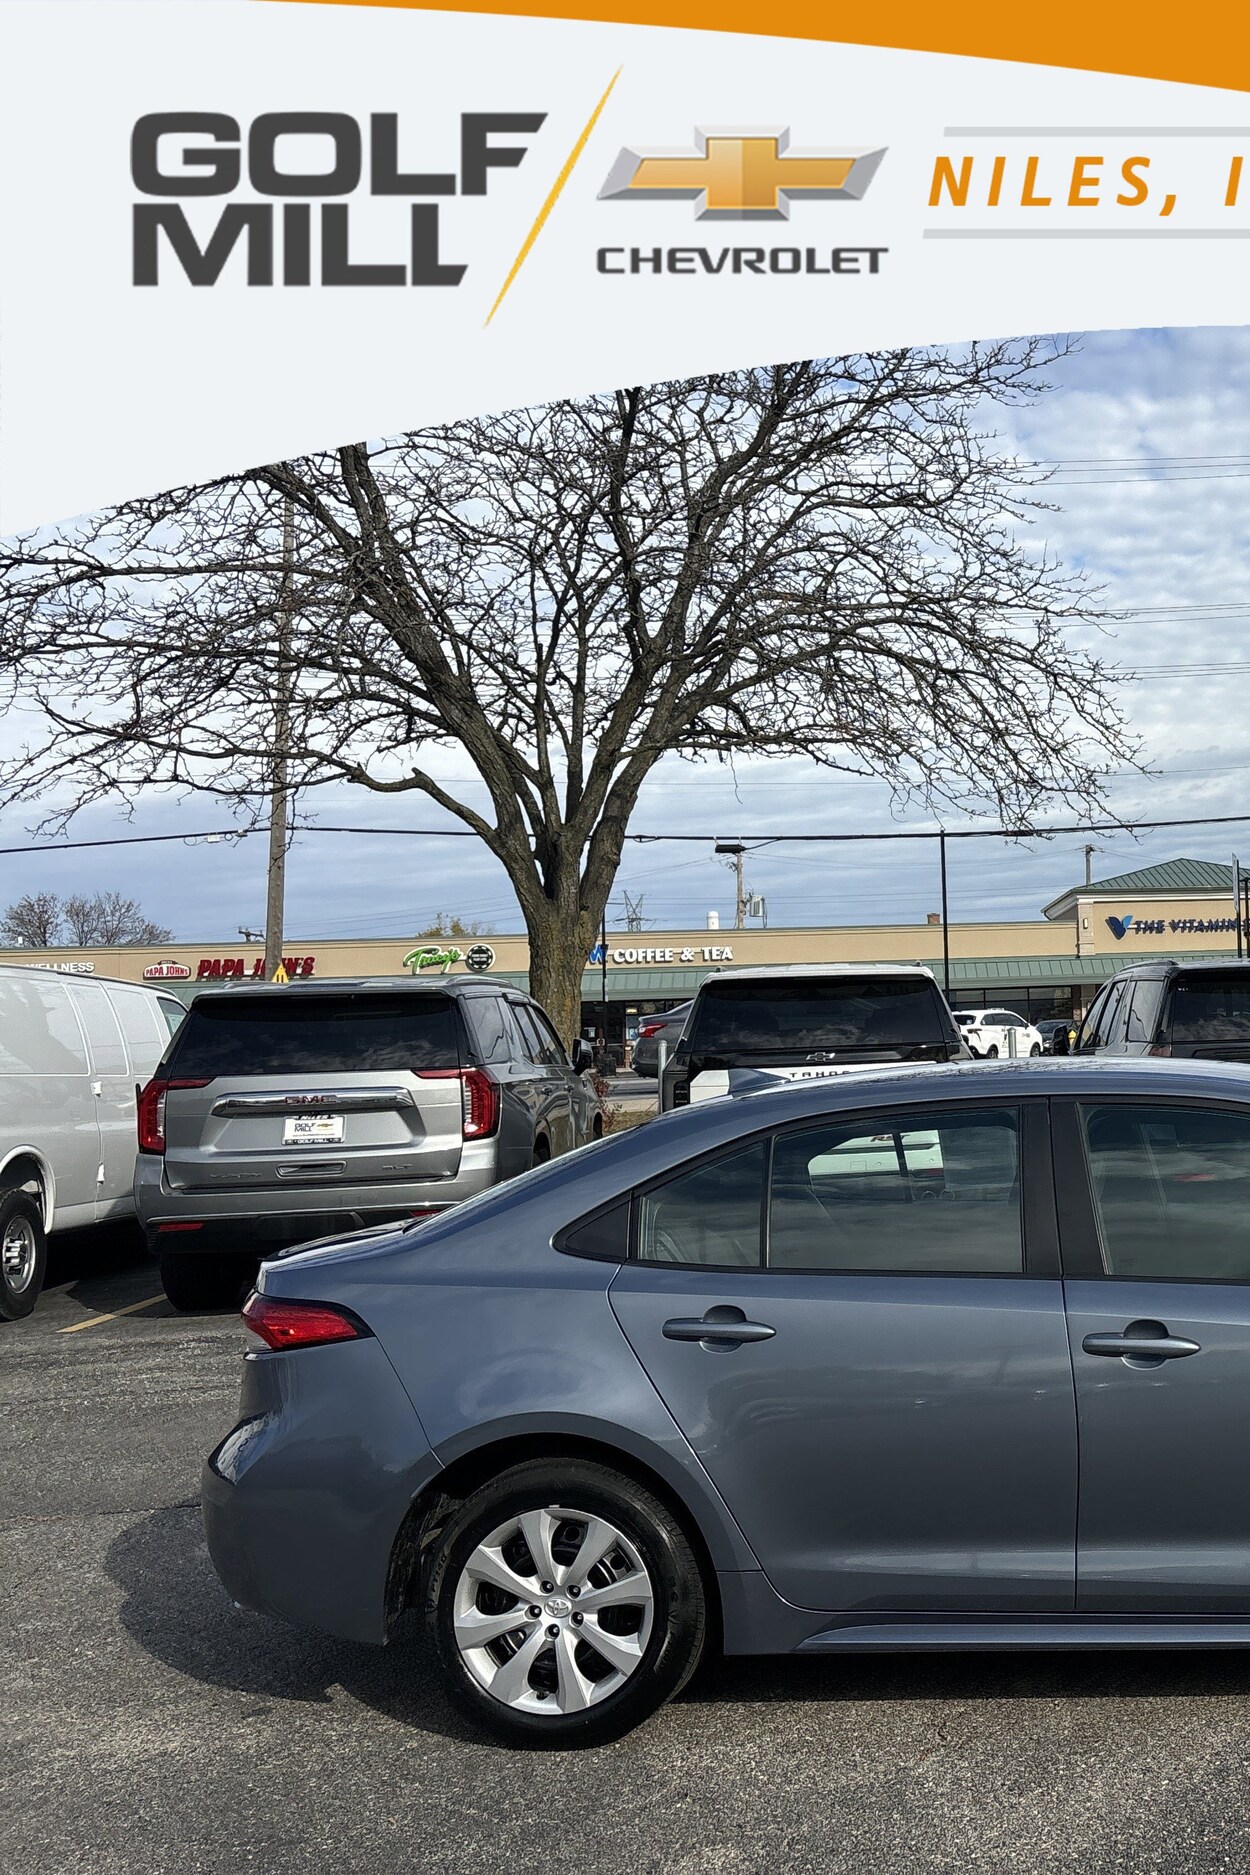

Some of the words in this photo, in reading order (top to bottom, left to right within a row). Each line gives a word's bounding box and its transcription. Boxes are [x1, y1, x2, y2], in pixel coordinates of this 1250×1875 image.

[1134, 919, 1166, 935] THE
[1168, 917, 1239, 934] VITAMIN
[612, 948, 674, 965] COFFEE
[681, 947, 695, 962] &
[701, 946, 734, 962] TEA
[145, 966, 164, 976] PAPA
[198, 959, 244, 977] PAPA
[252, 957, 315, 976] JN'S
[285, 1095, 338, 1105] GMC
